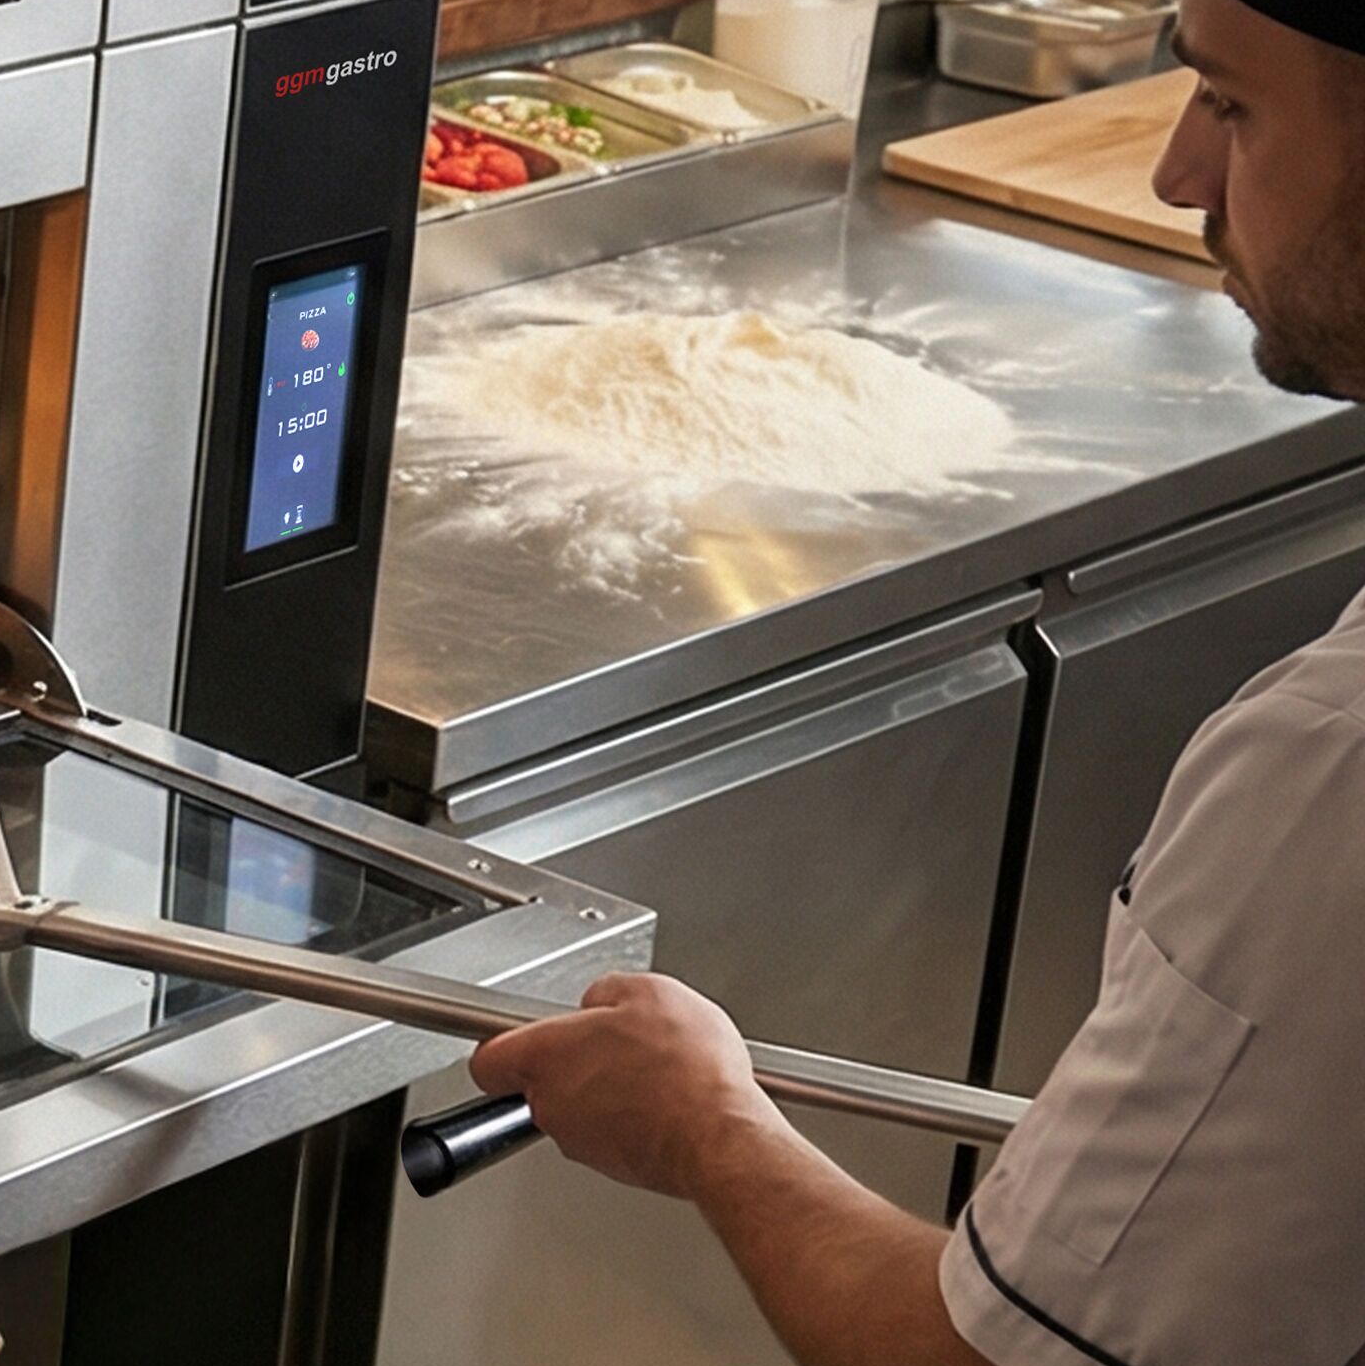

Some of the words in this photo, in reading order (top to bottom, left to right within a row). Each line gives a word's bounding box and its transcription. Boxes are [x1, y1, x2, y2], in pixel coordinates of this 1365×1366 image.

[275, 50, 397, 98] ggmgastro
[299, 306, 327, 321] PIZZA
[278, 408, 328, 437] 15:00
